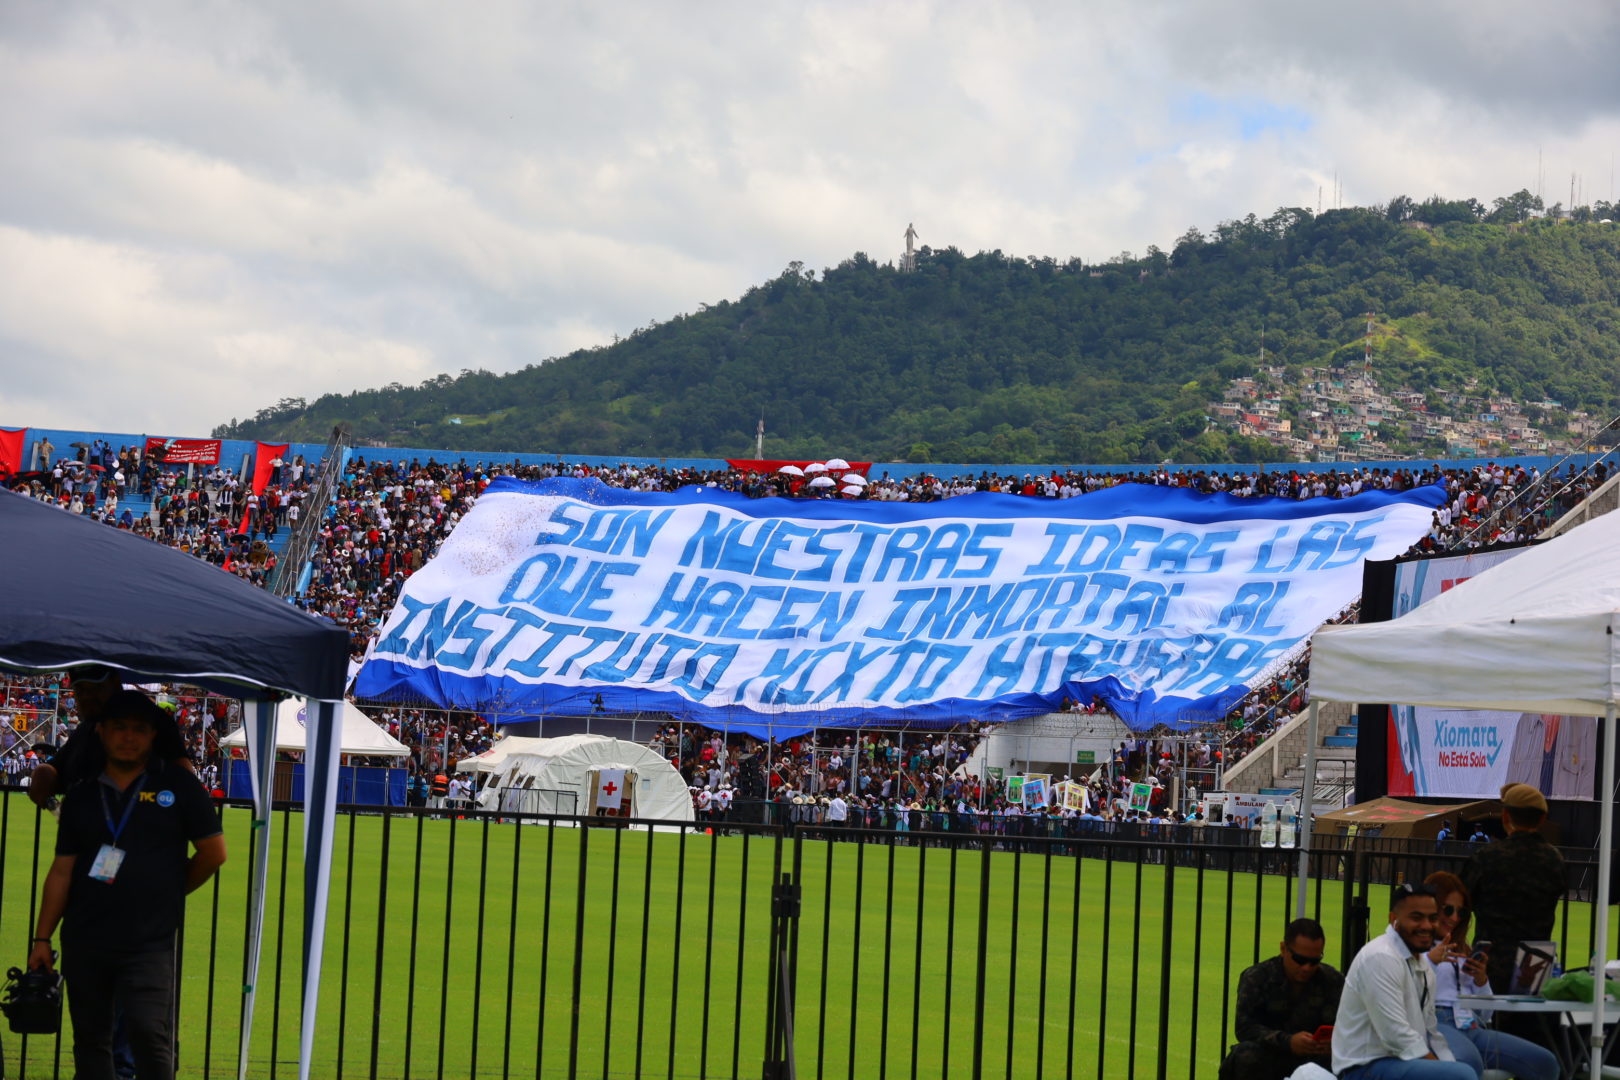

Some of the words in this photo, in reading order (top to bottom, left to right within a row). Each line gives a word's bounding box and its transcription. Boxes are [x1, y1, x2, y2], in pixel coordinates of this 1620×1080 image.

[534, 501, 676, 558] SON
[678, 510, 1014, 582] NUESTRAS
[1024, 522, 1240, 575] IDEAS
[1244, 514, 1384, 575] LAS
[498, 553, 642, 622] QUE
[640, 571, 865, 642] HACEN
[864, 572, 1185, 642] INMORTAL
[1206, 579, 1291, 637] AL
[375, 594, 741, 702] INSTITUTO
[735, 638, 974, 705] MIXTO
[17, 719, 24, 729] 3
[1434, 719, 1498, 748] Xiomara
[1438, 751, 1450, 768] No
[1451, 750, 1469, 768] Está
[1470, 751, 1487, 768] Sola
